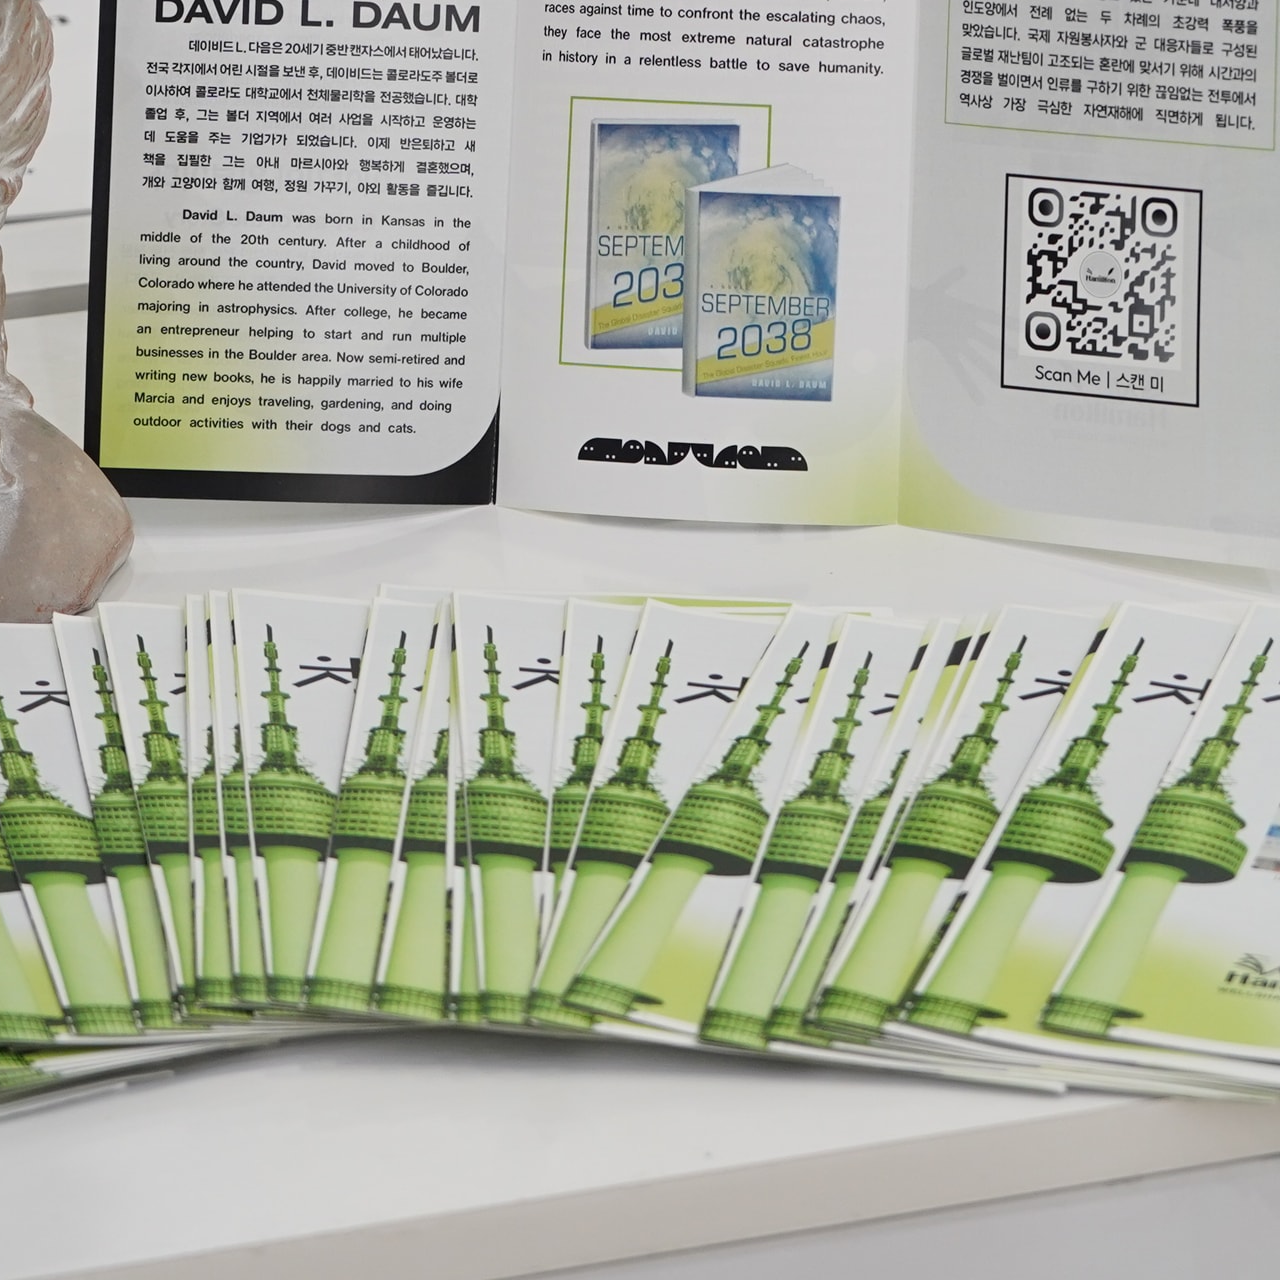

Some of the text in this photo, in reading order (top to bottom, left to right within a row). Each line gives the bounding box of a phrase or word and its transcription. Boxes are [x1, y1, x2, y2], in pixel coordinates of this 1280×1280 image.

[300, 0, 334, 28] L.
[352, 0, 481, 33] DAUM
[543, 24, 885, 52] they face the most extreme natural catastrophe
[961, 22, 1258, 59] 맞았습니다. 국제 자원봉사자와 군 대응자들로 구성된
[145, 84, 479, 107] 이사하여 콜로라도 대학교에서 천체물리학을 전공했습니다. 대학
[182, 208, 472, 229] David L. Daum was born in Kansas in the
[598, 235, 684, 257] SEPTEM
[613, 262, 684, 308] 203
[701, 292, 830, 318] SEPTEMBER
[717, 318, 812, 360] 2038
[1035, 365, 1164, 393] Scan Me 스캔 미
[132, 415, 417, 435] outdoor activities with their dogs and cats.
